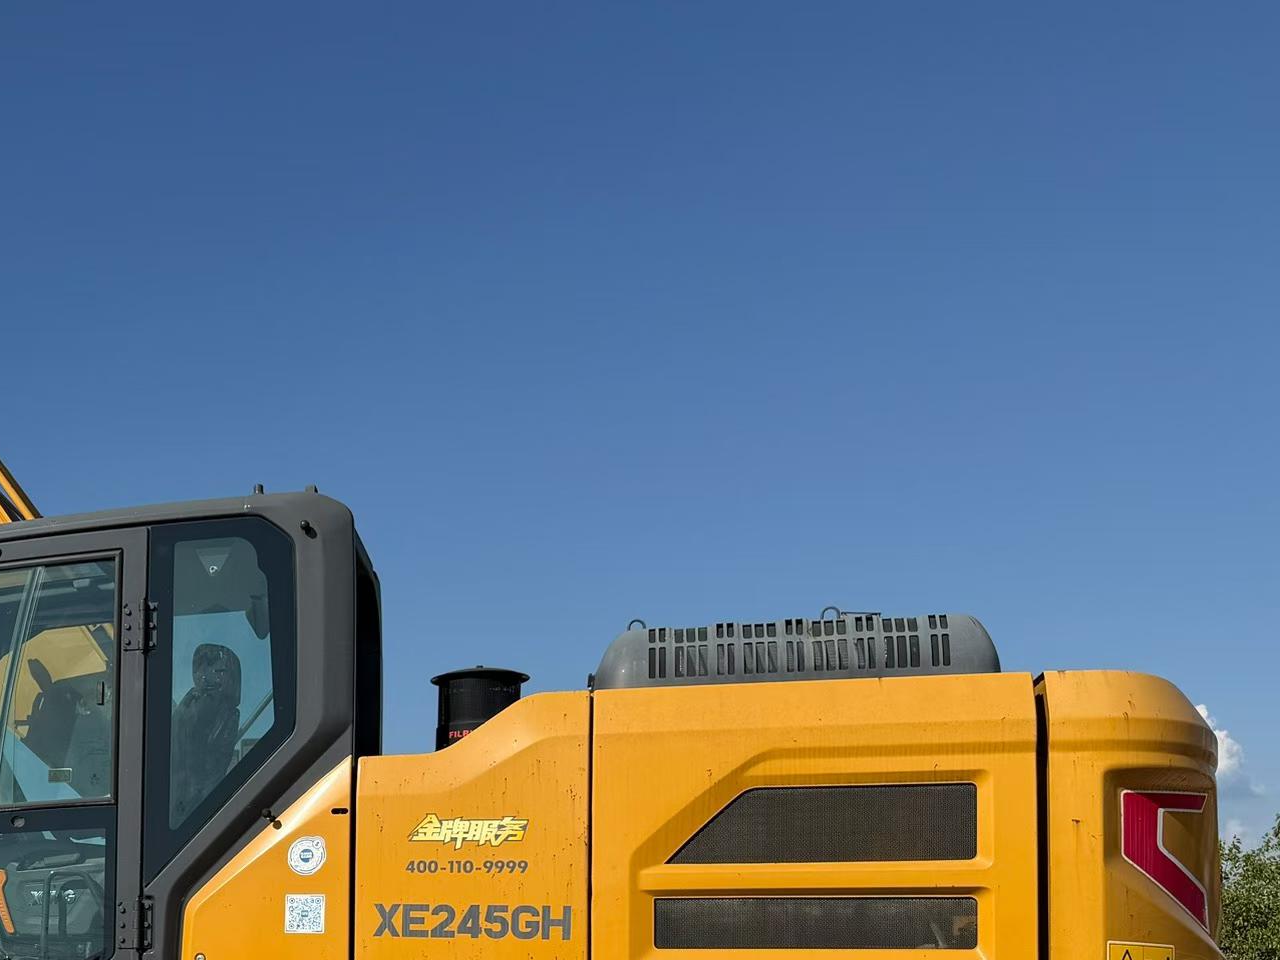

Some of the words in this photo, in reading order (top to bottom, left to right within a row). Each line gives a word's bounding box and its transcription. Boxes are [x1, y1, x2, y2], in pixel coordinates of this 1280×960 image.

[408, 813, 529, 850] 金牌服务
[406, 860, 529, 874] 400-110-9999
[373, 903, 572, 941] XE245GH
